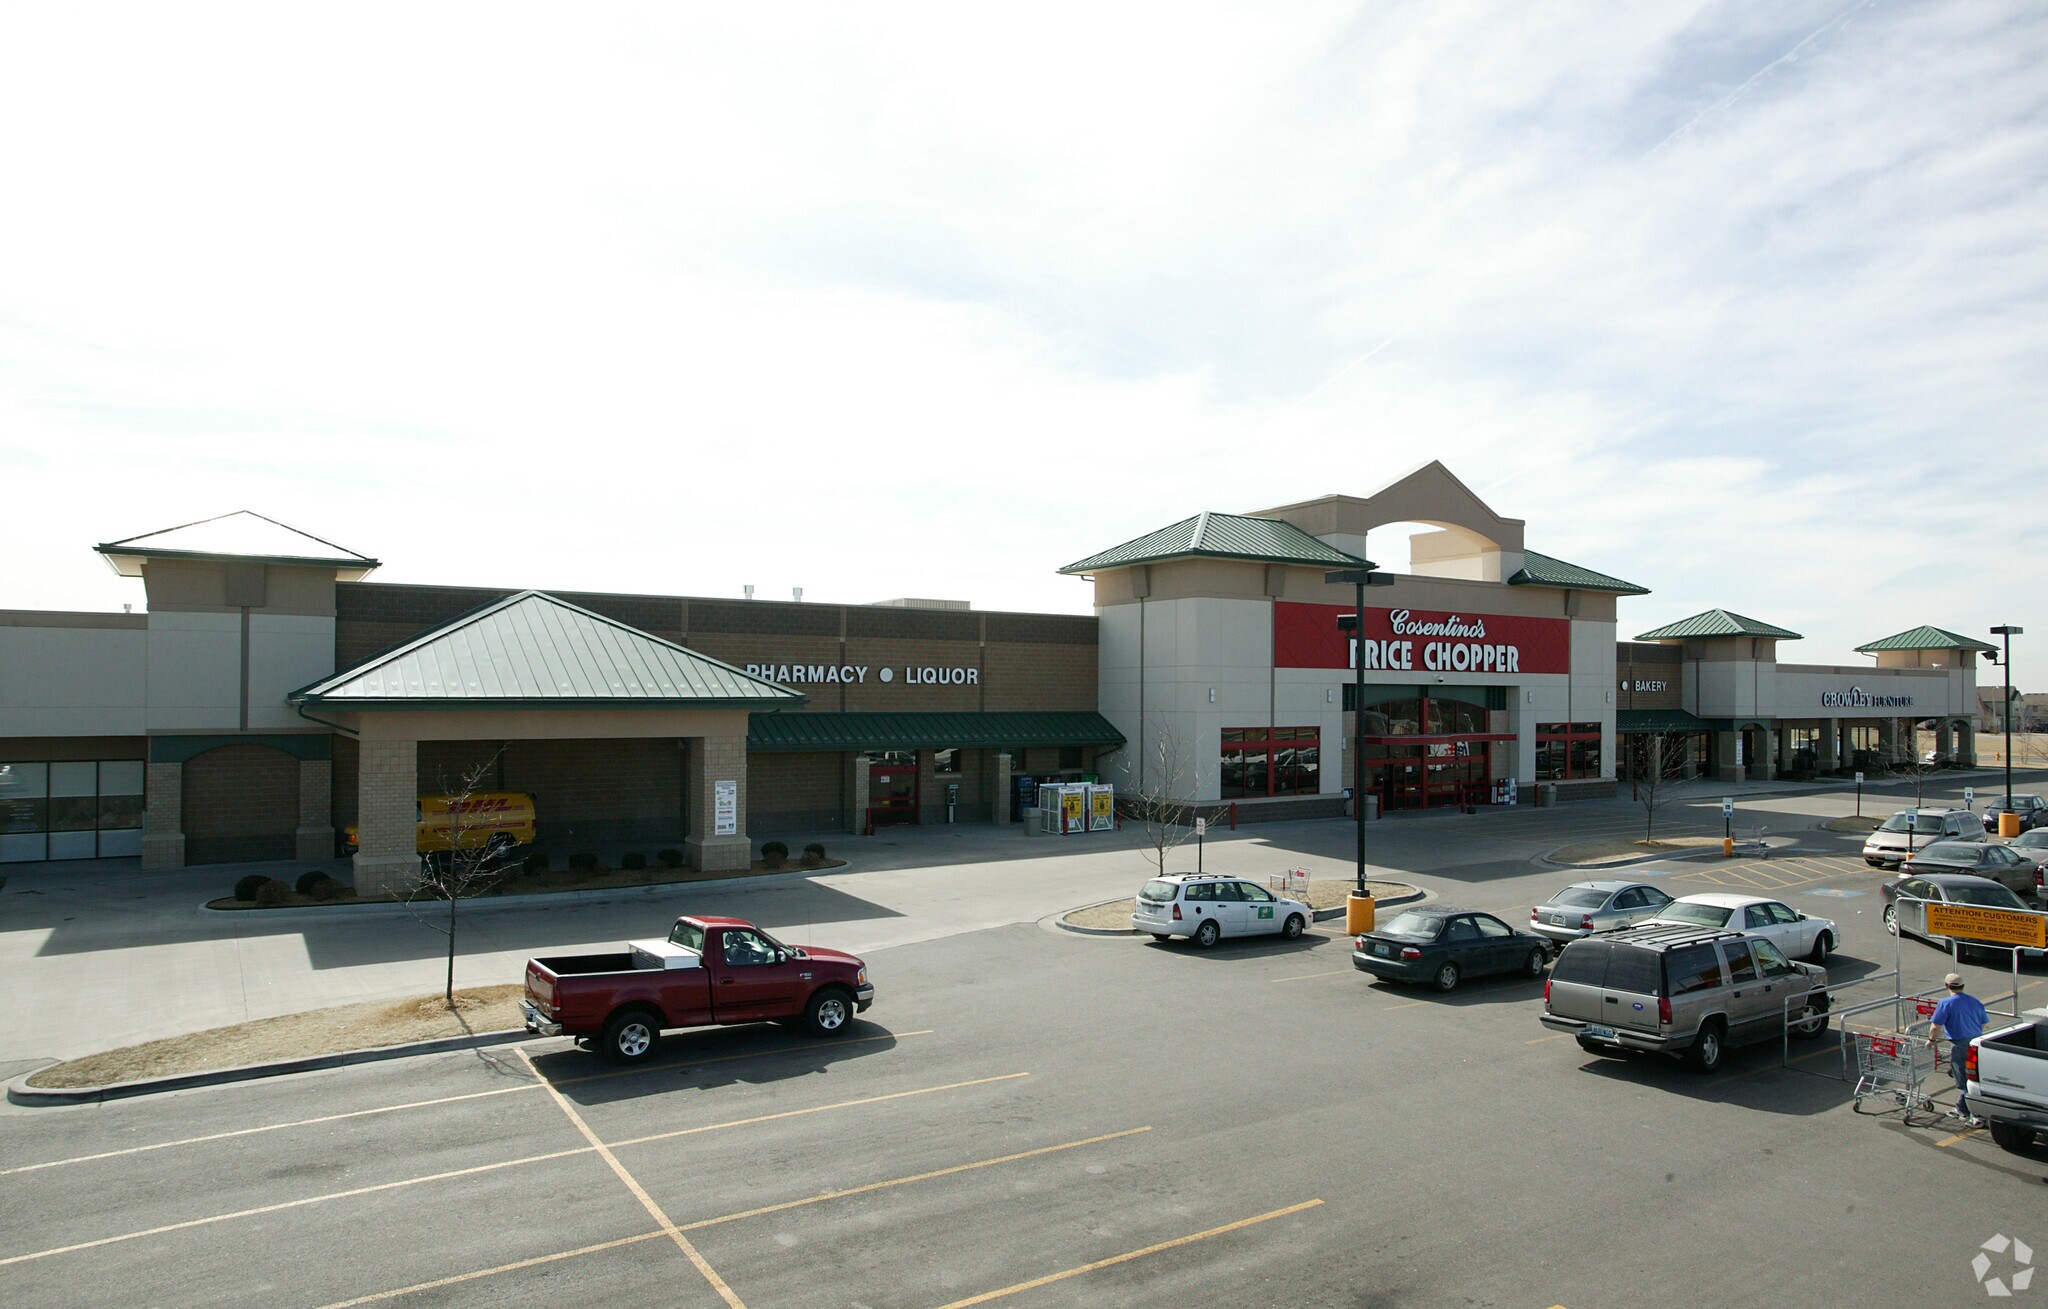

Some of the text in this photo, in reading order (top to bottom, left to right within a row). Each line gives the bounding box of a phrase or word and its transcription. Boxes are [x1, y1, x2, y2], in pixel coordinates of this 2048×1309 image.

[1390, 609, 1486, 639] Cosentino's
[1424, 642, 1519, 673] CHOPPER
[906, 667, 978, 685] LIQUOR
[1635, 680, 1667, 692] BAKERY
[1822, 686, 1871, 707] CROWLEY
[446, 798, 513, 815] DHL
[1933, 907, 1981, 917] ATTENTION
[1983, 911, 2038, 924] CUSTOMERS
[1946, 922, 1975, 930] CANNOT
[1988, 926, 2039, 938] RESPONSIBLE
